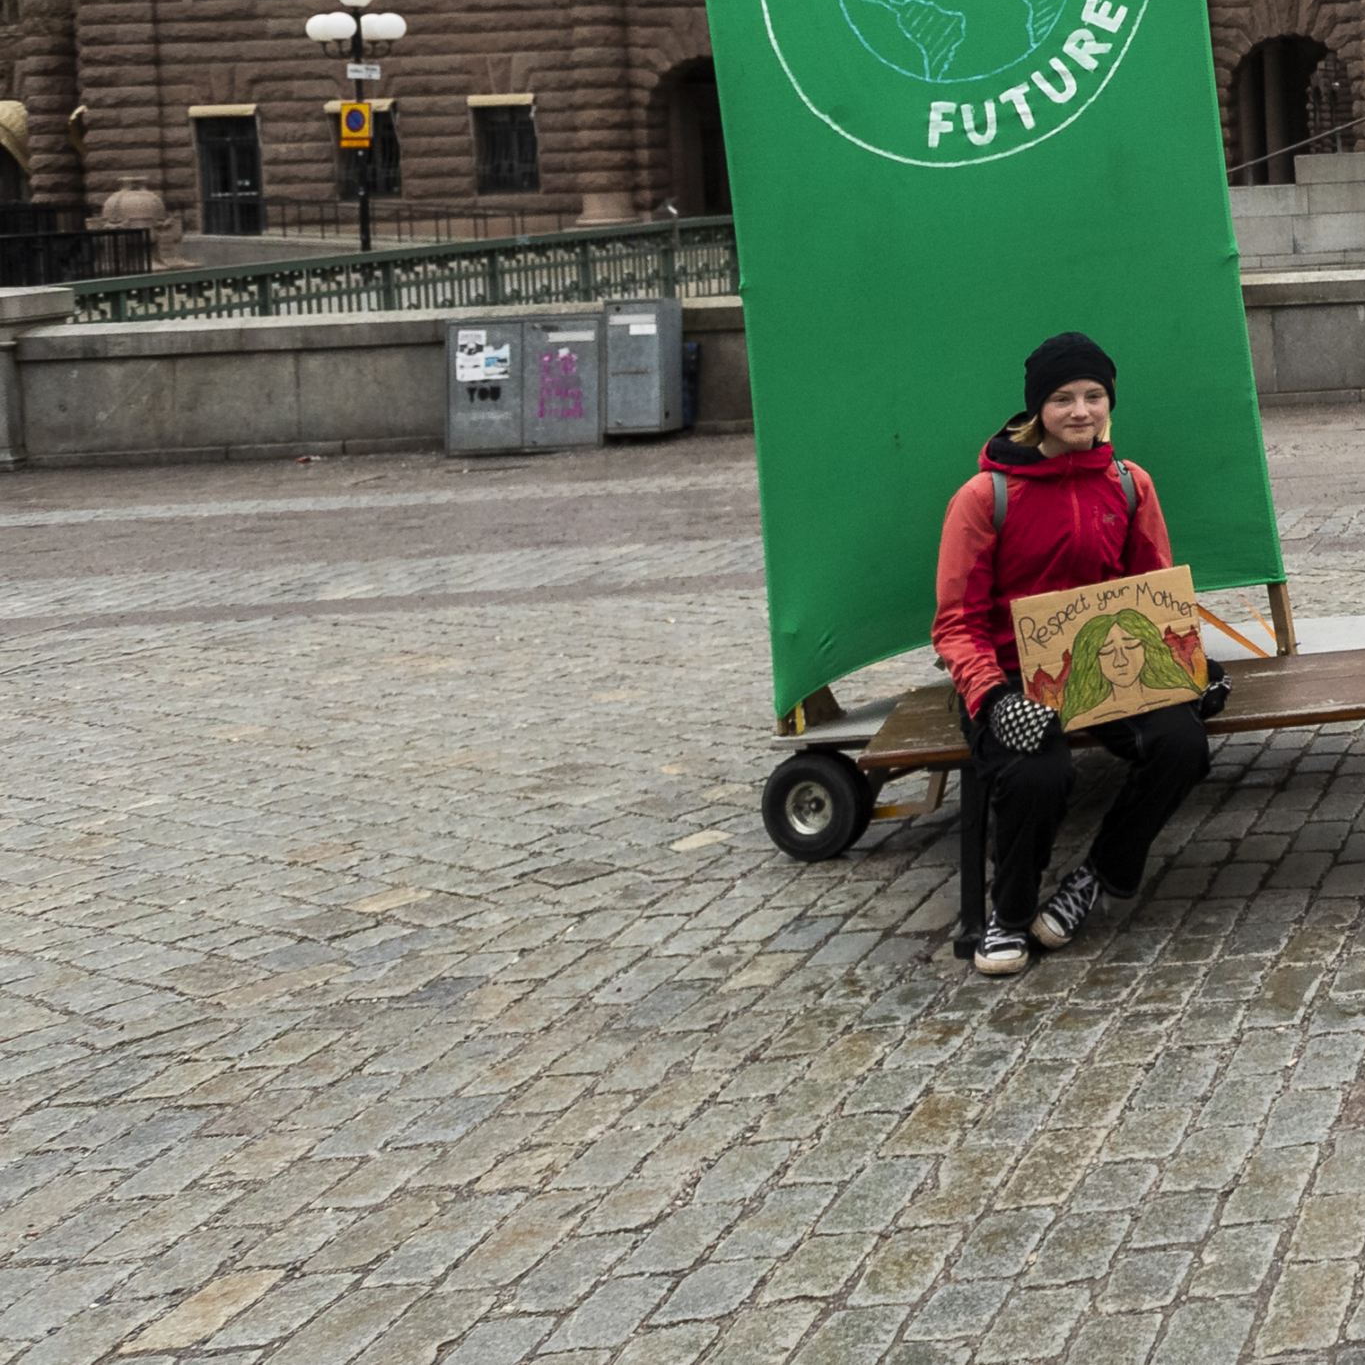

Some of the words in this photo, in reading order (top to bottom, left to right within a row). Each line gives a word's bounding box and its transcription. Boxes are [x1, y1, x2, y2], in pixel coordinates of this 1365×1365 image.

[1018, 593, 1090, 656] Respect
[1096, 585, 1130, 611] your
[1136, 582, 1198, 617] Mother
